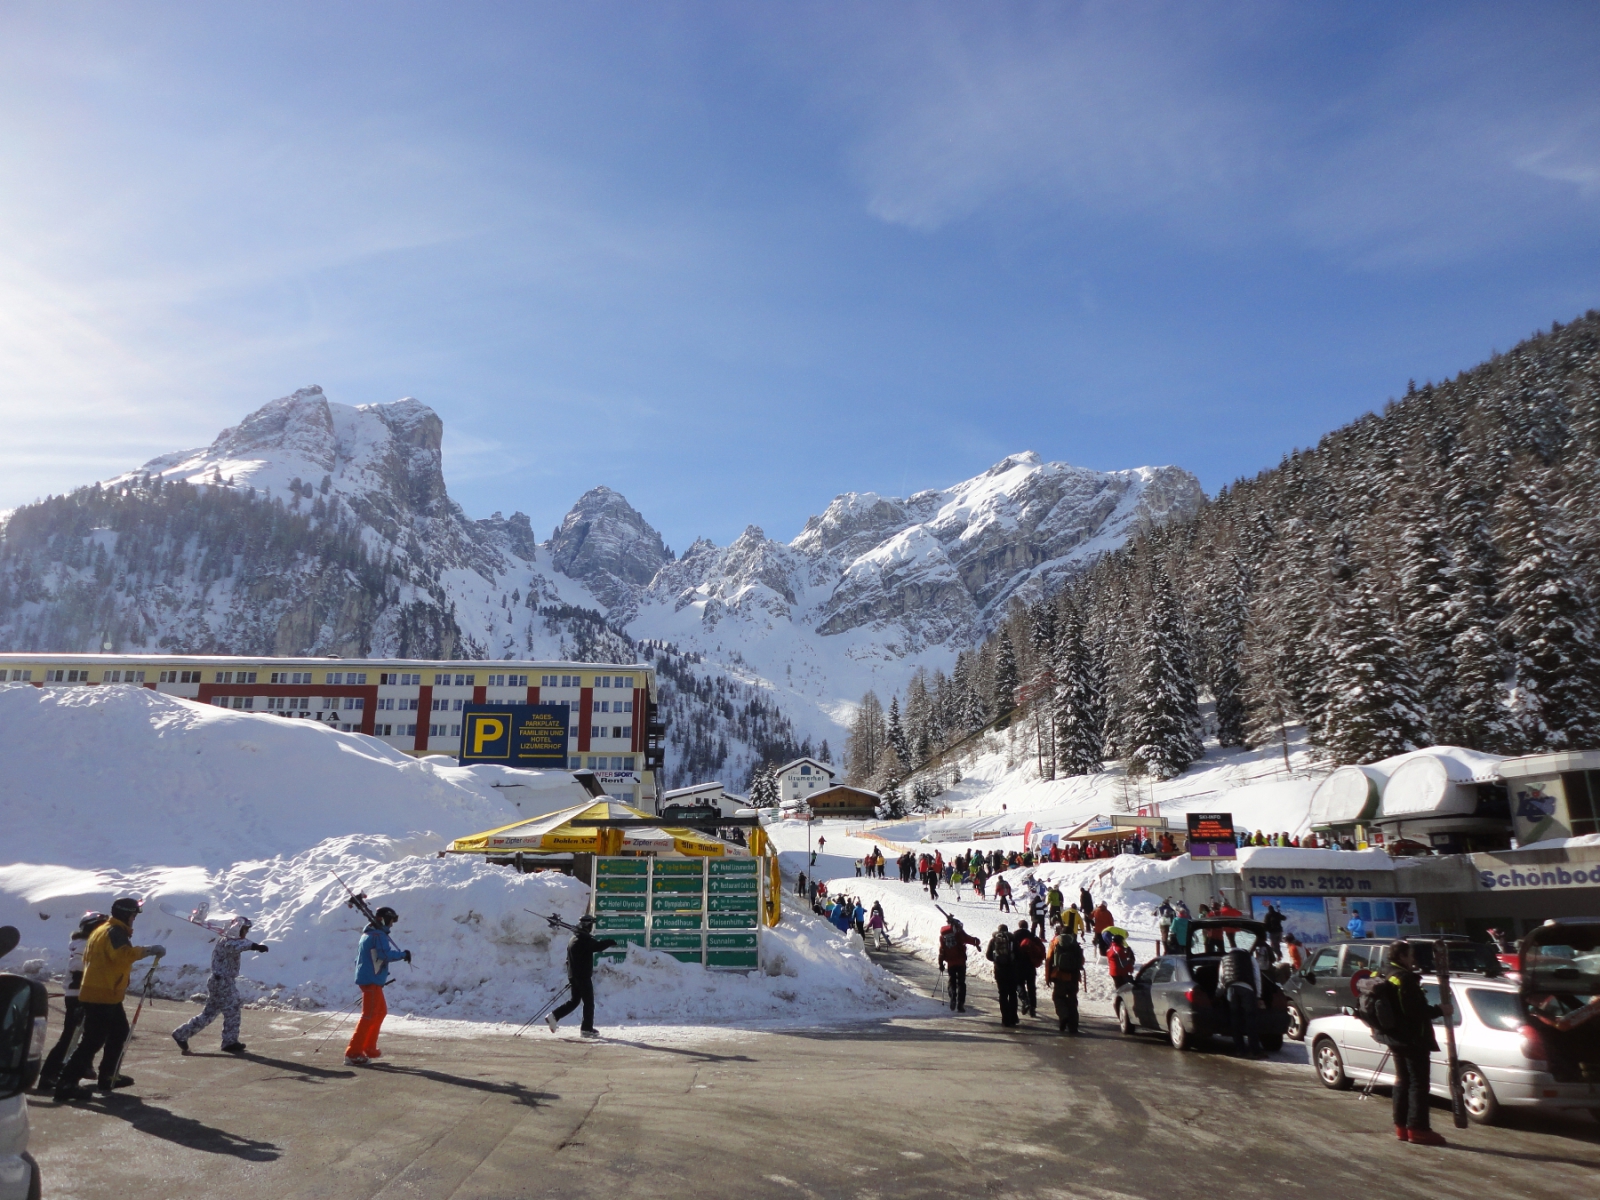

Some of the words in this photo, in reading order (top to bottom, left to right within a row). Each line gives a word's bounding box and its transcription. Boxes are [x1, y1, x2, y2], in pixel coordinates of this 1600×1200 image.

[473, 718, 504, 753] P
[632, 839, 652, 847] Zipfer
[720, 881, 740, 889] Restaurant
[1249, 876, 1287, 889] 1560
[1290, 879, 1304, 889] m
[1317, 877, 1354, 890] 2120
[1358, 880, 1372, 890] m
[607, 900, 621, 908] Hotel
[622, 900, 645, 909] Olympia
[709, 937, 736, 945] Sunnalm
